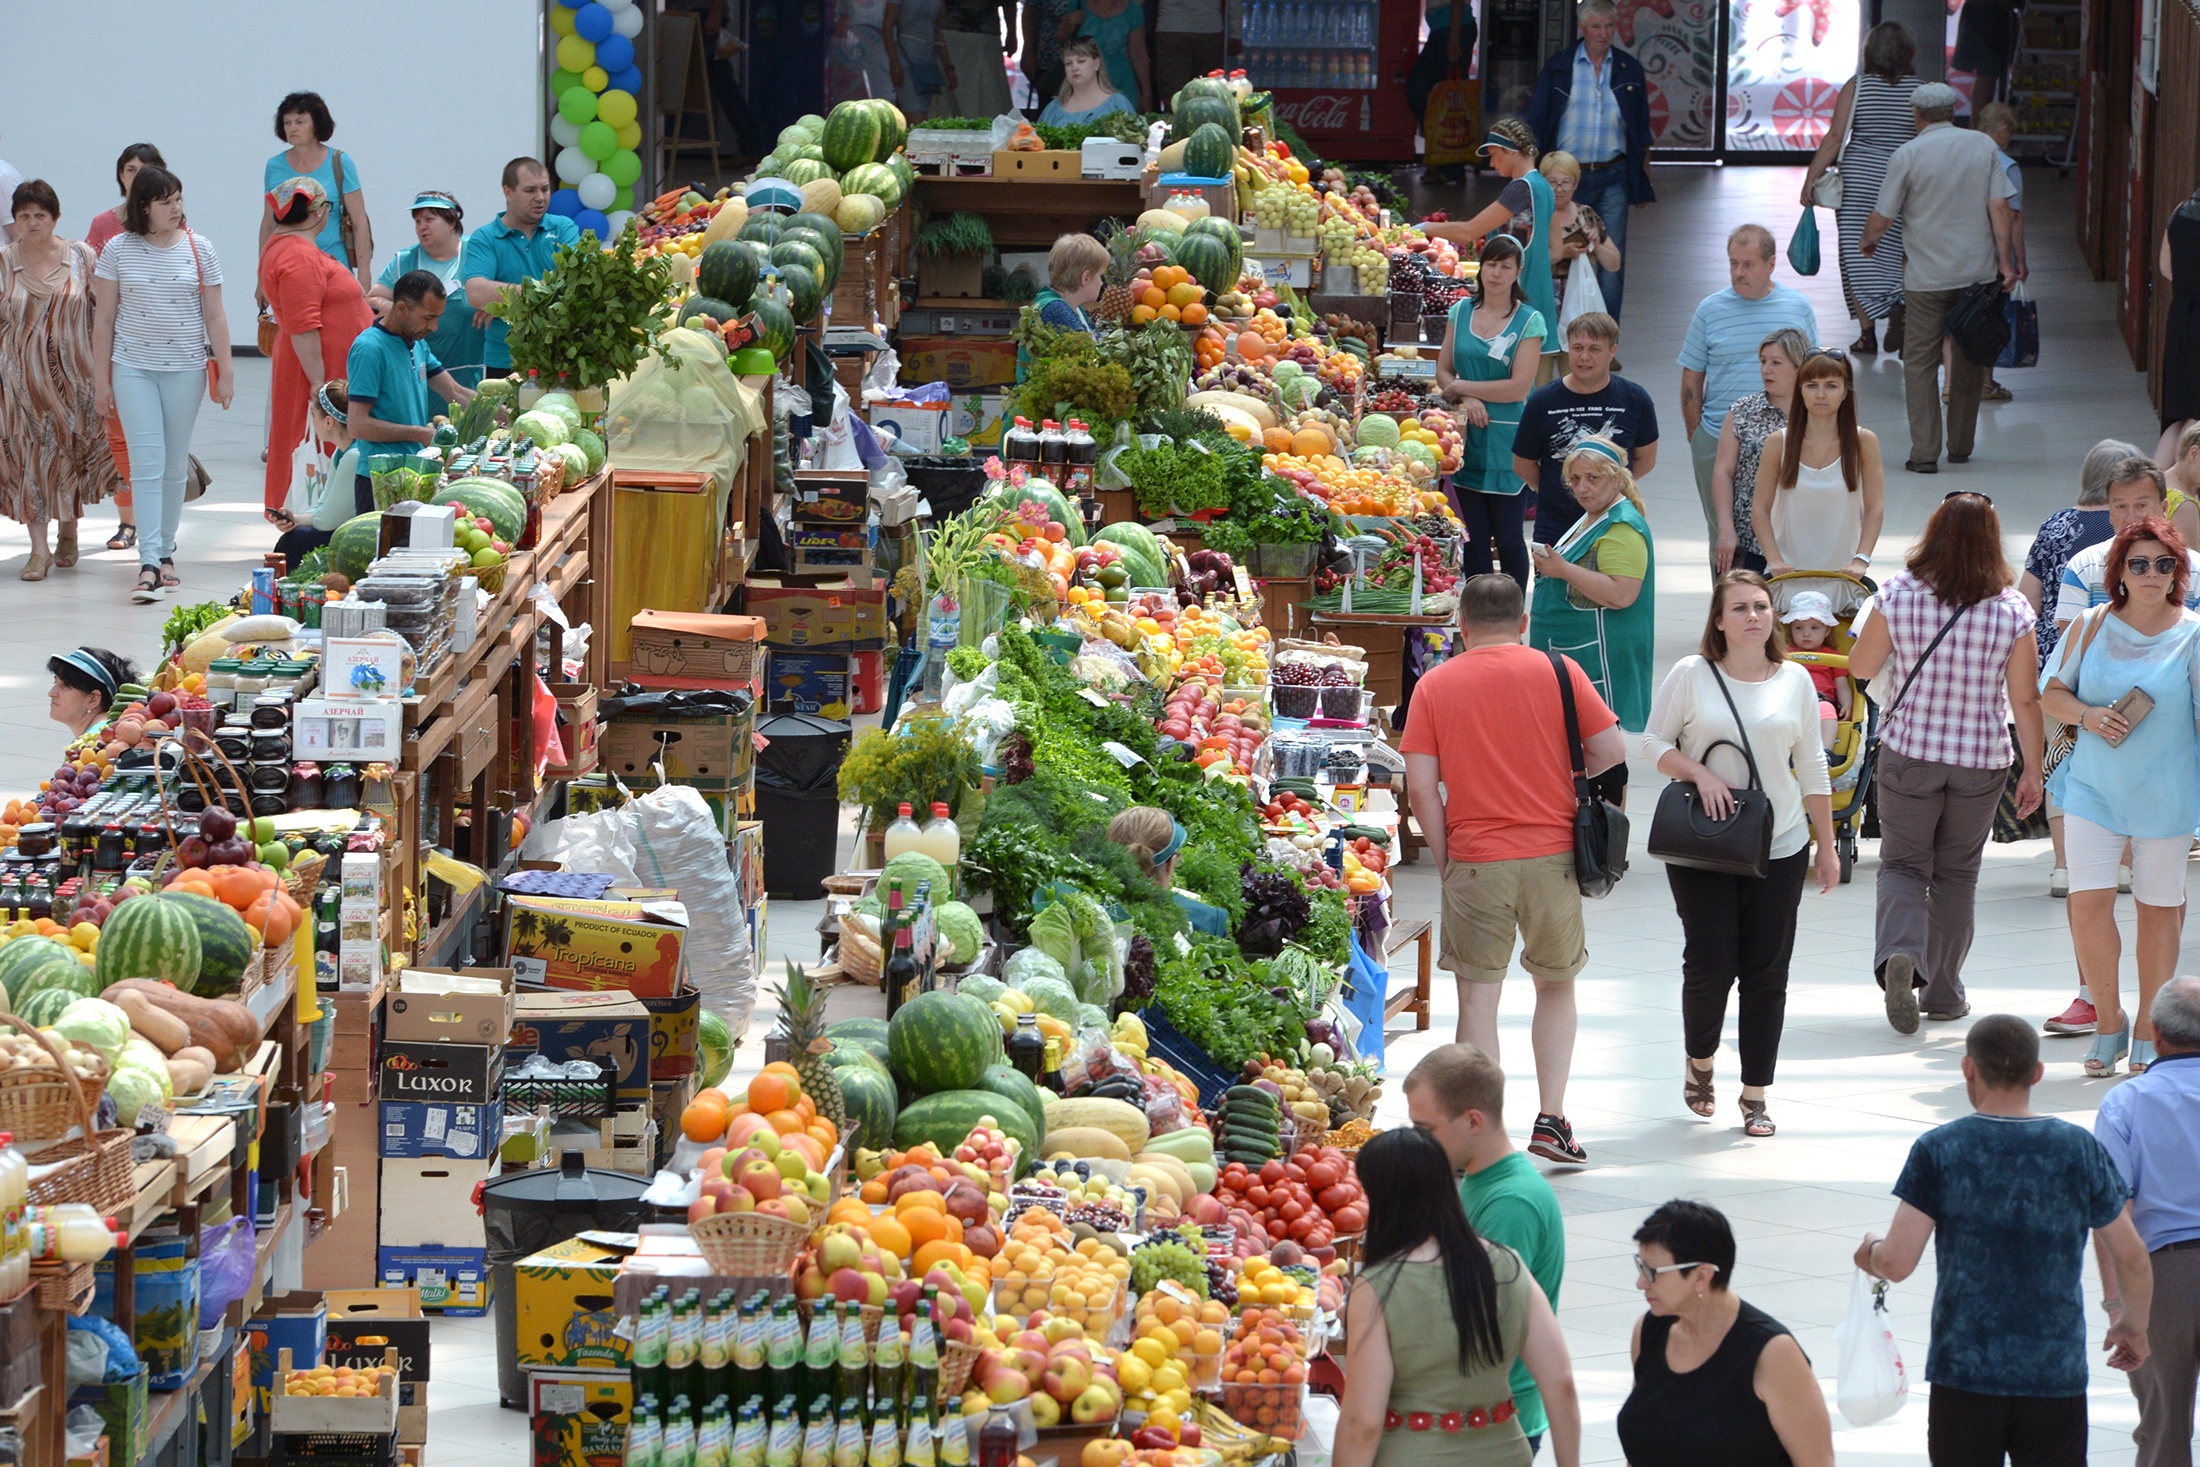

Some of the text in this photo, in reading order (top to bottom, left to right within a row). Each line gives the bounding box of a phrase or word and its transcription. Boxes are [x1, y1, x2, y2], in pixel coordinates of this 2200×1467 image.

[800, 537, 838, 546] LIDER
[323, 706, 364, 715] АЗЕРЧАЙ
[575, 921, 657, 939] PRODUCT OF ECUADOR
[552, 945, 636, 973] Tropicana
[395, 1002, 405, 1010] 138
[508, 1023, 539, 1047] ole
[420, 1287, 446, 1299] Malki
[576, 1348, 615, 1358] Fazenda
